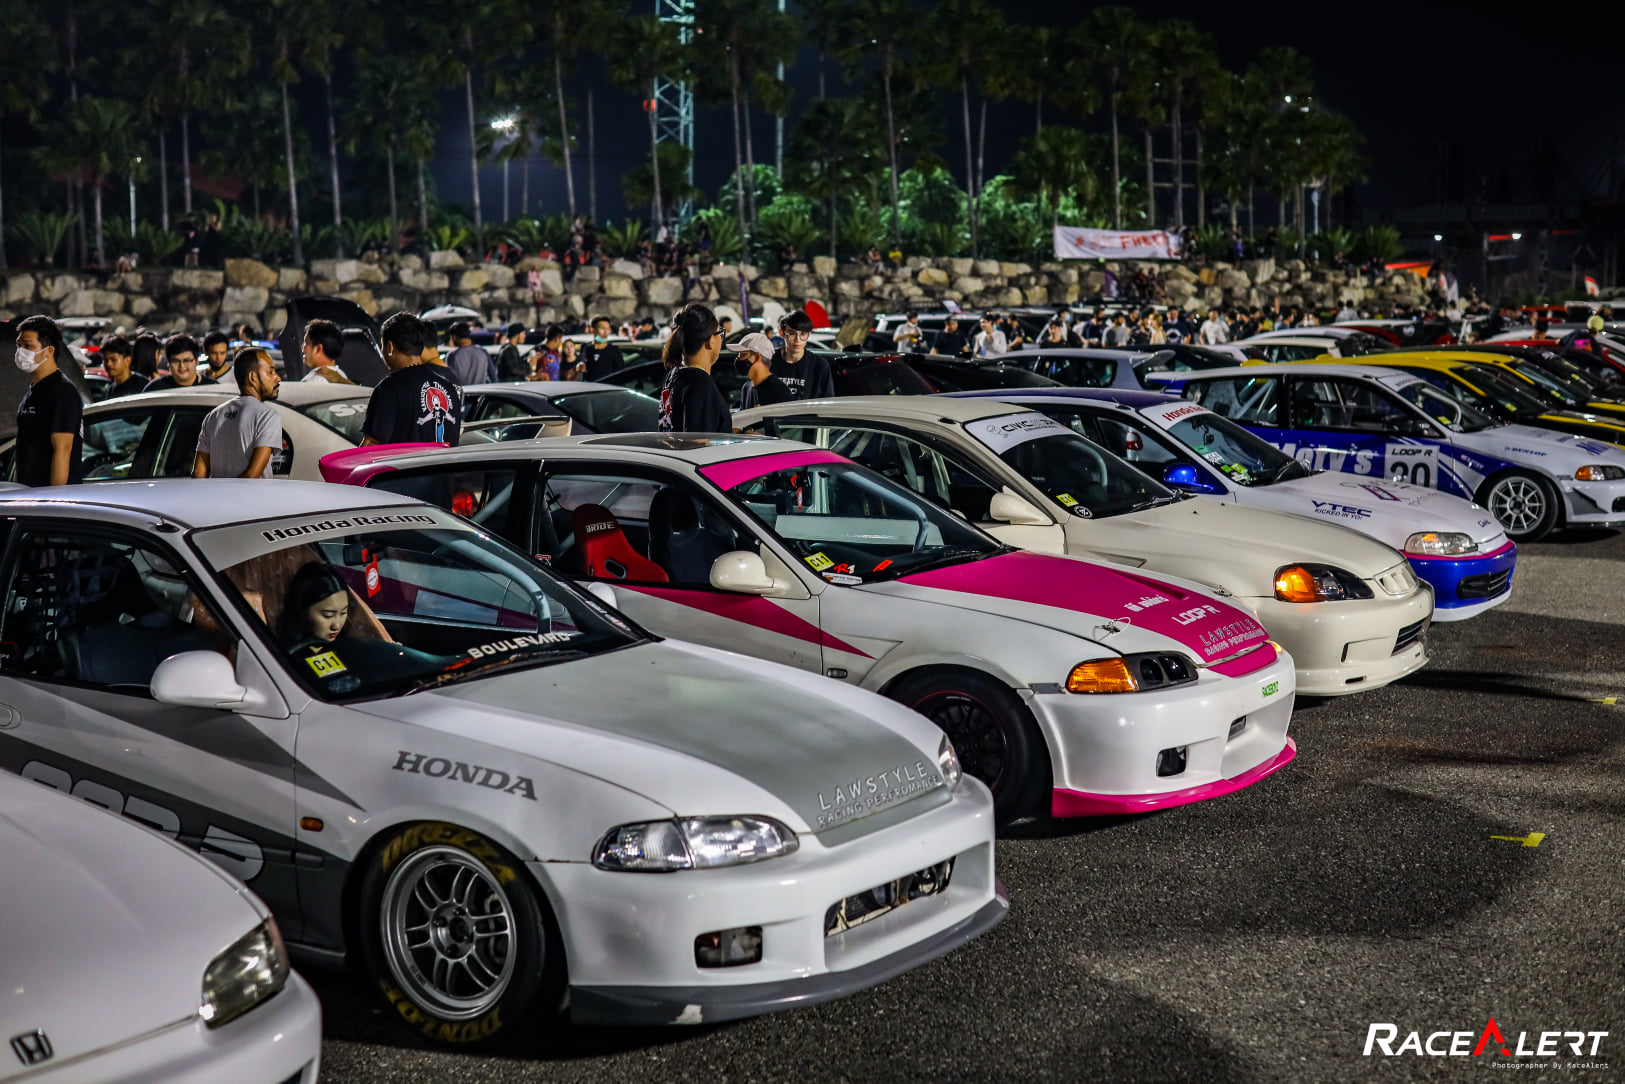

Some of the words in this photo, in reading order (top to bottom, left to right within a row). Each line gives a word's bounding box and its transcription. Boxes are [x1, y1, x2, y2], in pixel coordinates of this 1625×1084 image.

[1391, 447, 1422, 456] LOOP
[1511, 447, 1547, 457] DUNLOP
[1311, 500, 1373, 518] VTEC
[1314, 507, 1341, 517] KICKED
[1341, 511, 1349, 519] IN
[261, 518, 352, 543] Honda
[352, 514, 438, 527] Racing
[585, 521, 616, 533] BRIDE
[809, 555, 831, 567] C11
[1171, 607, 1207, 626] LOOP
[1205, 604, 1221, 614] R
[1199, 618, 1256, 646] LAWSTYLE
[467, 631, 571, 659] BOULEVARD
[1203, 640, 1230, 657] RACING
[312, 655, 341, 672] C11
[392, 750, 539, 802] HONDA
[818, 761, 928, 811] LAWSTYLE
[817, 801, 863, 829] RACING
